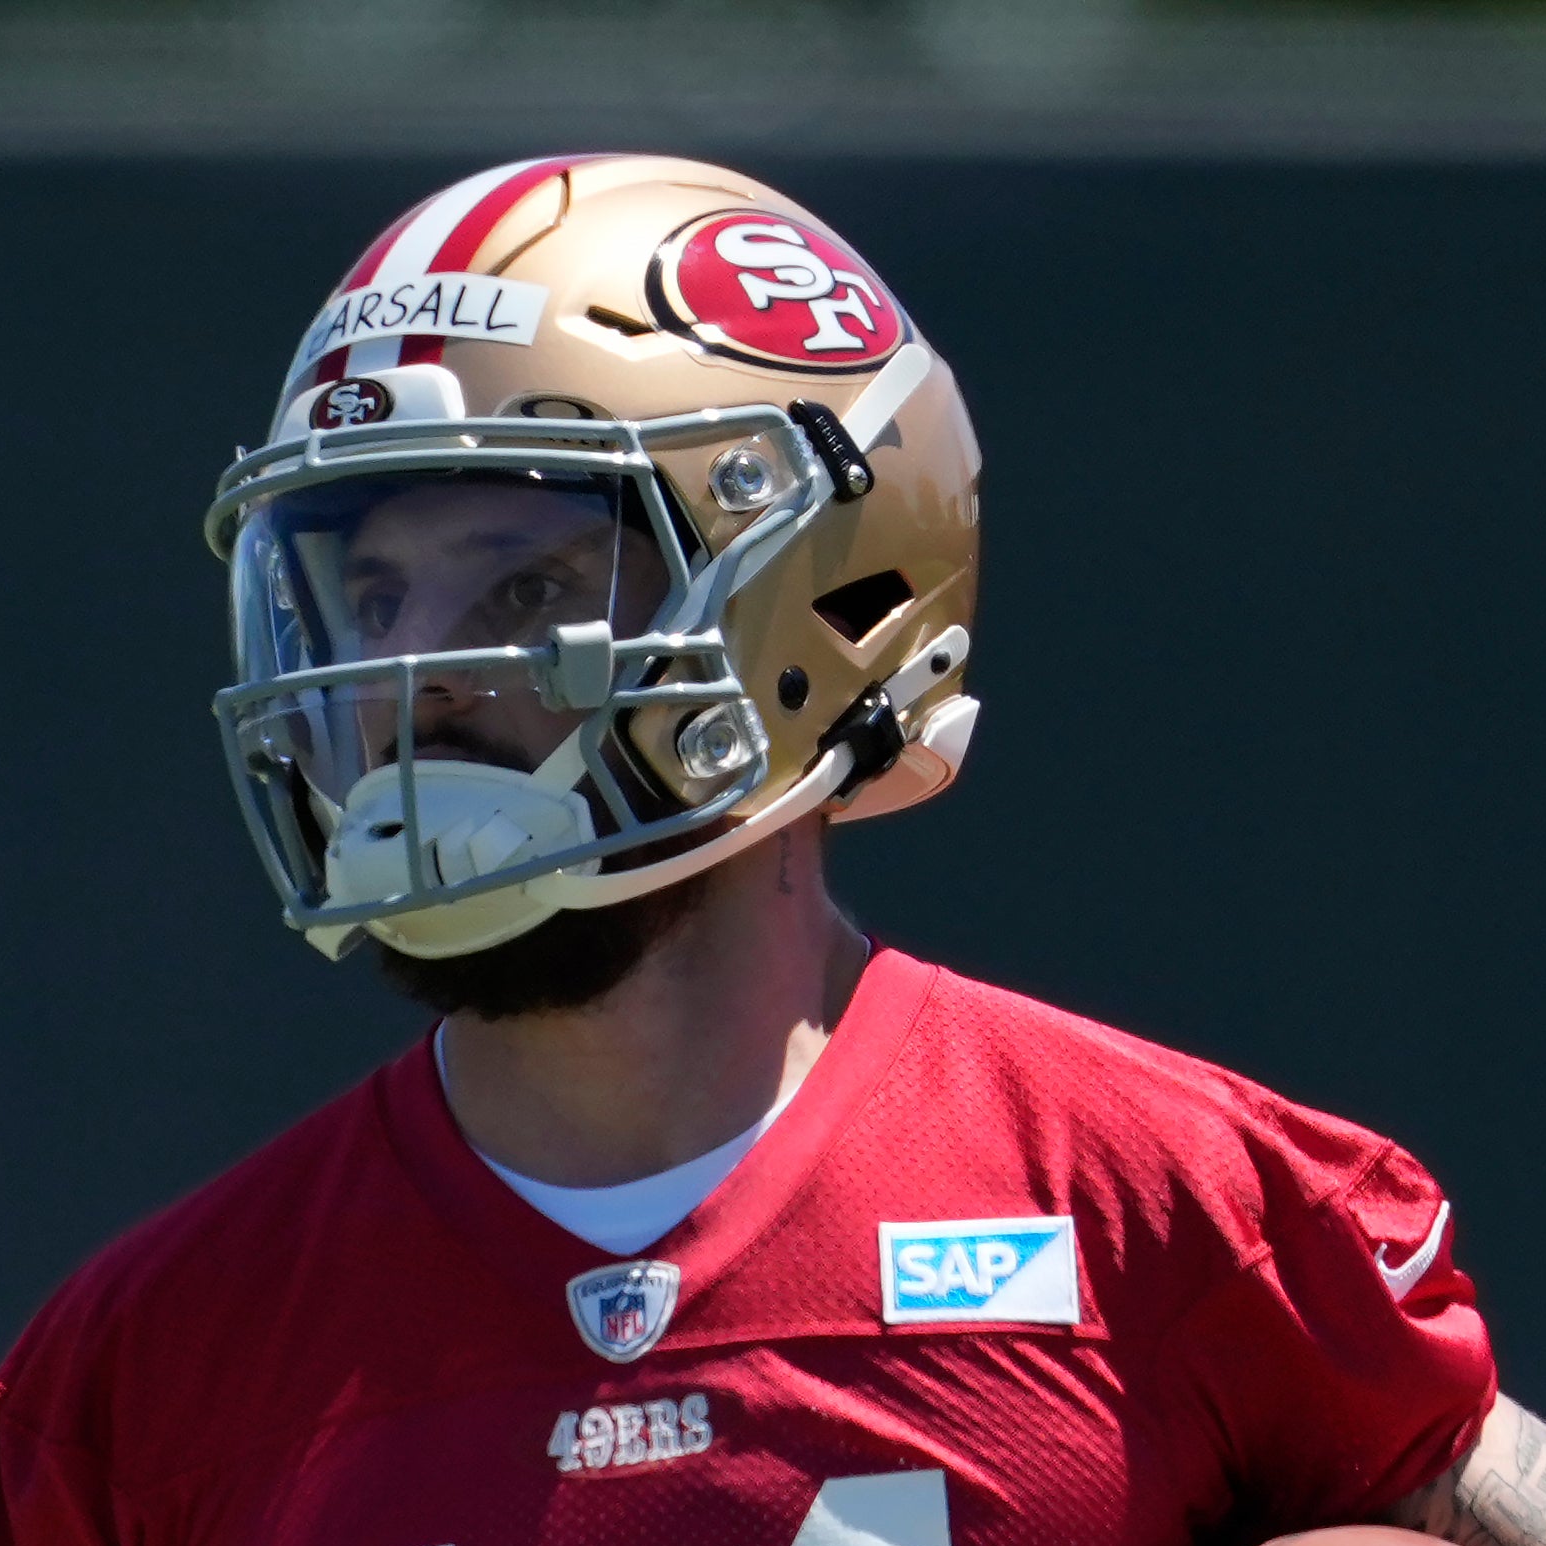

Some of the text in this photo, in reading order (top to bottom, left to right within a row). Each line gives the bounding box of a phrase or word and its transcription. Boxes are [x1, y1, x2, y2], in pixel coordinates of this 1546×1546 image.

[714, 222, 881, 352] SF
[895, 1240, 1020, 1298] SAP
[602, 1309, 646, 1342] NFL
[547, 1393, 714, 1474] 49ERS
